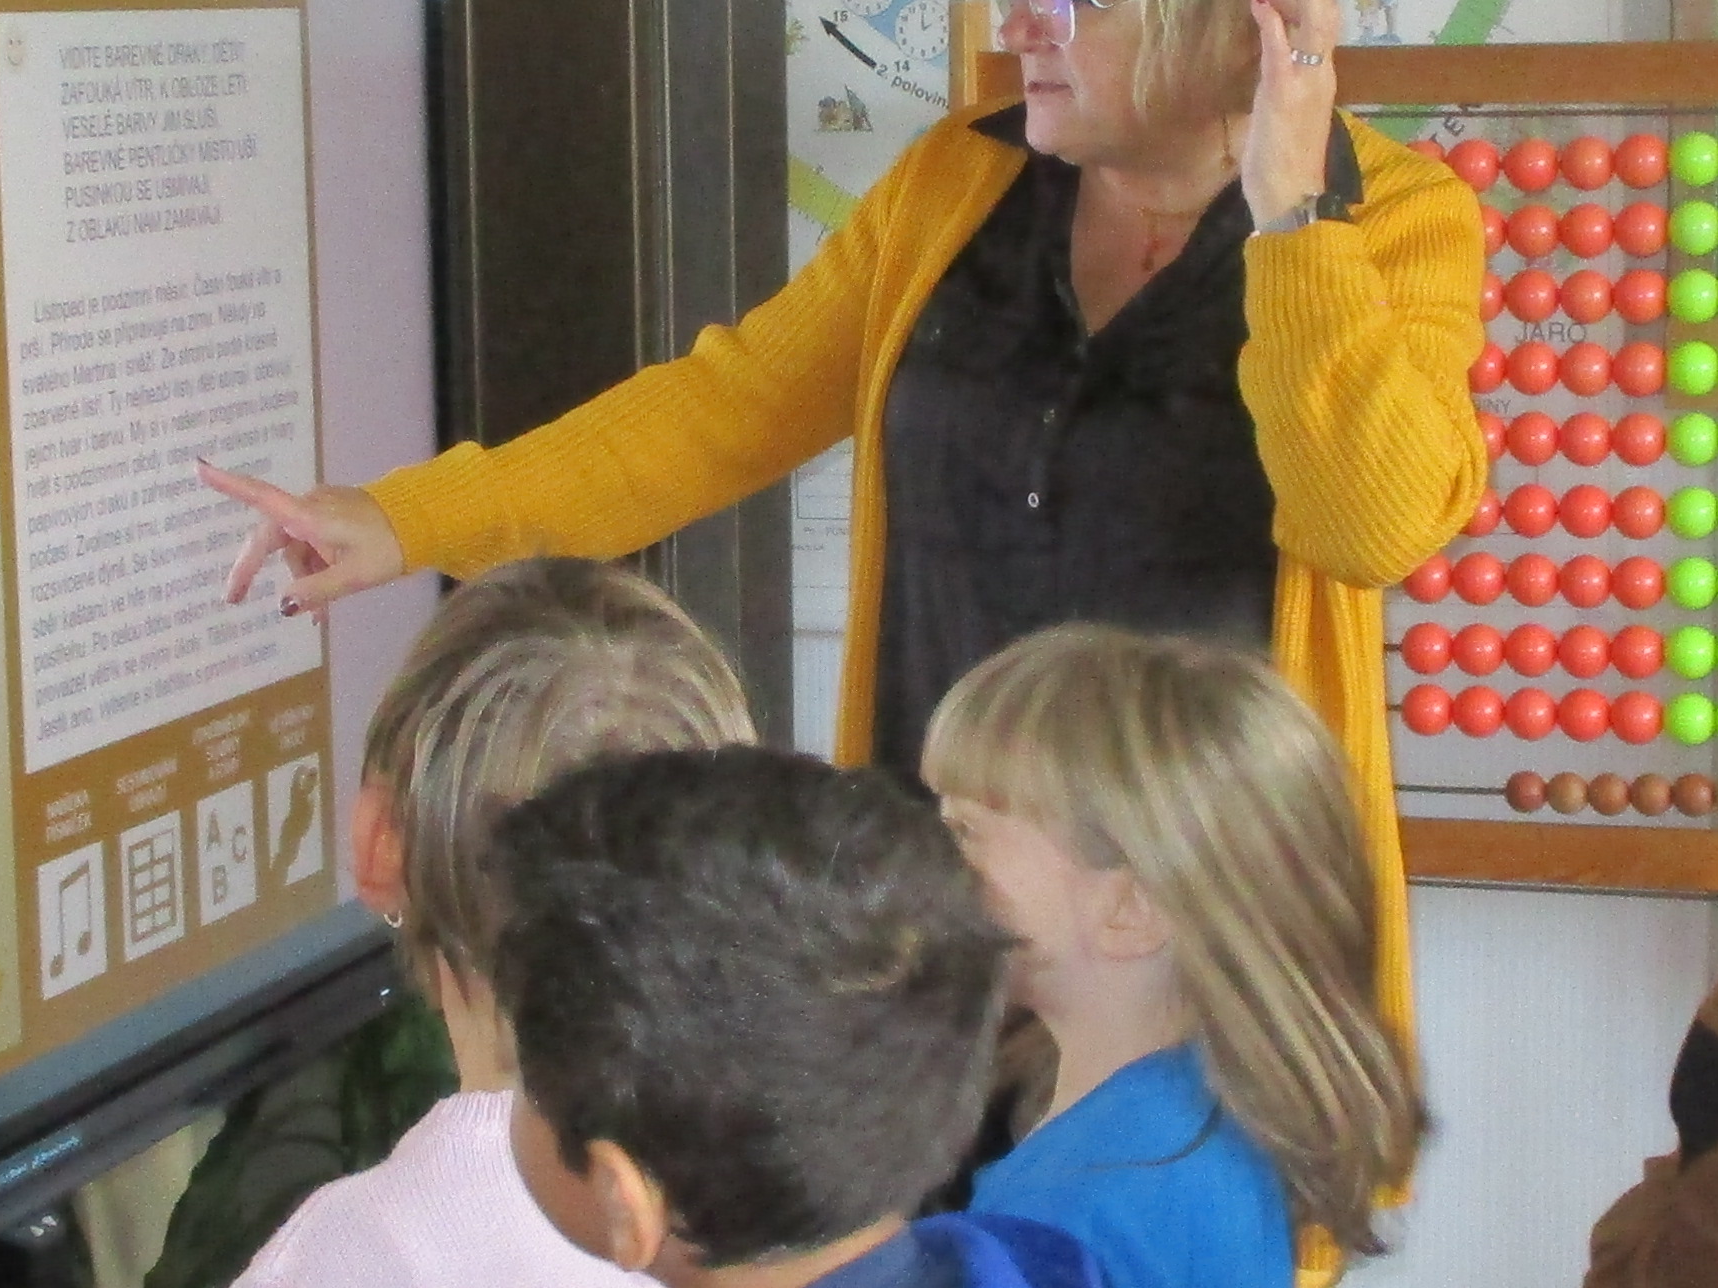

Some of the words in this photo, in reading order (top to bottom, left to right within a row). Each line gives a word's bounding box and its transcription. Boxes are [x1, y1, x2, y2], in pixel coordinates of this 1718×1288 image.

[890, 74, 949, 109] polovin
[1514, 320, 1588, 345] JARO
[206, 808, 222, 852] A
[232, 826, 247, 863] C
[213, 865, 228, 905] B
